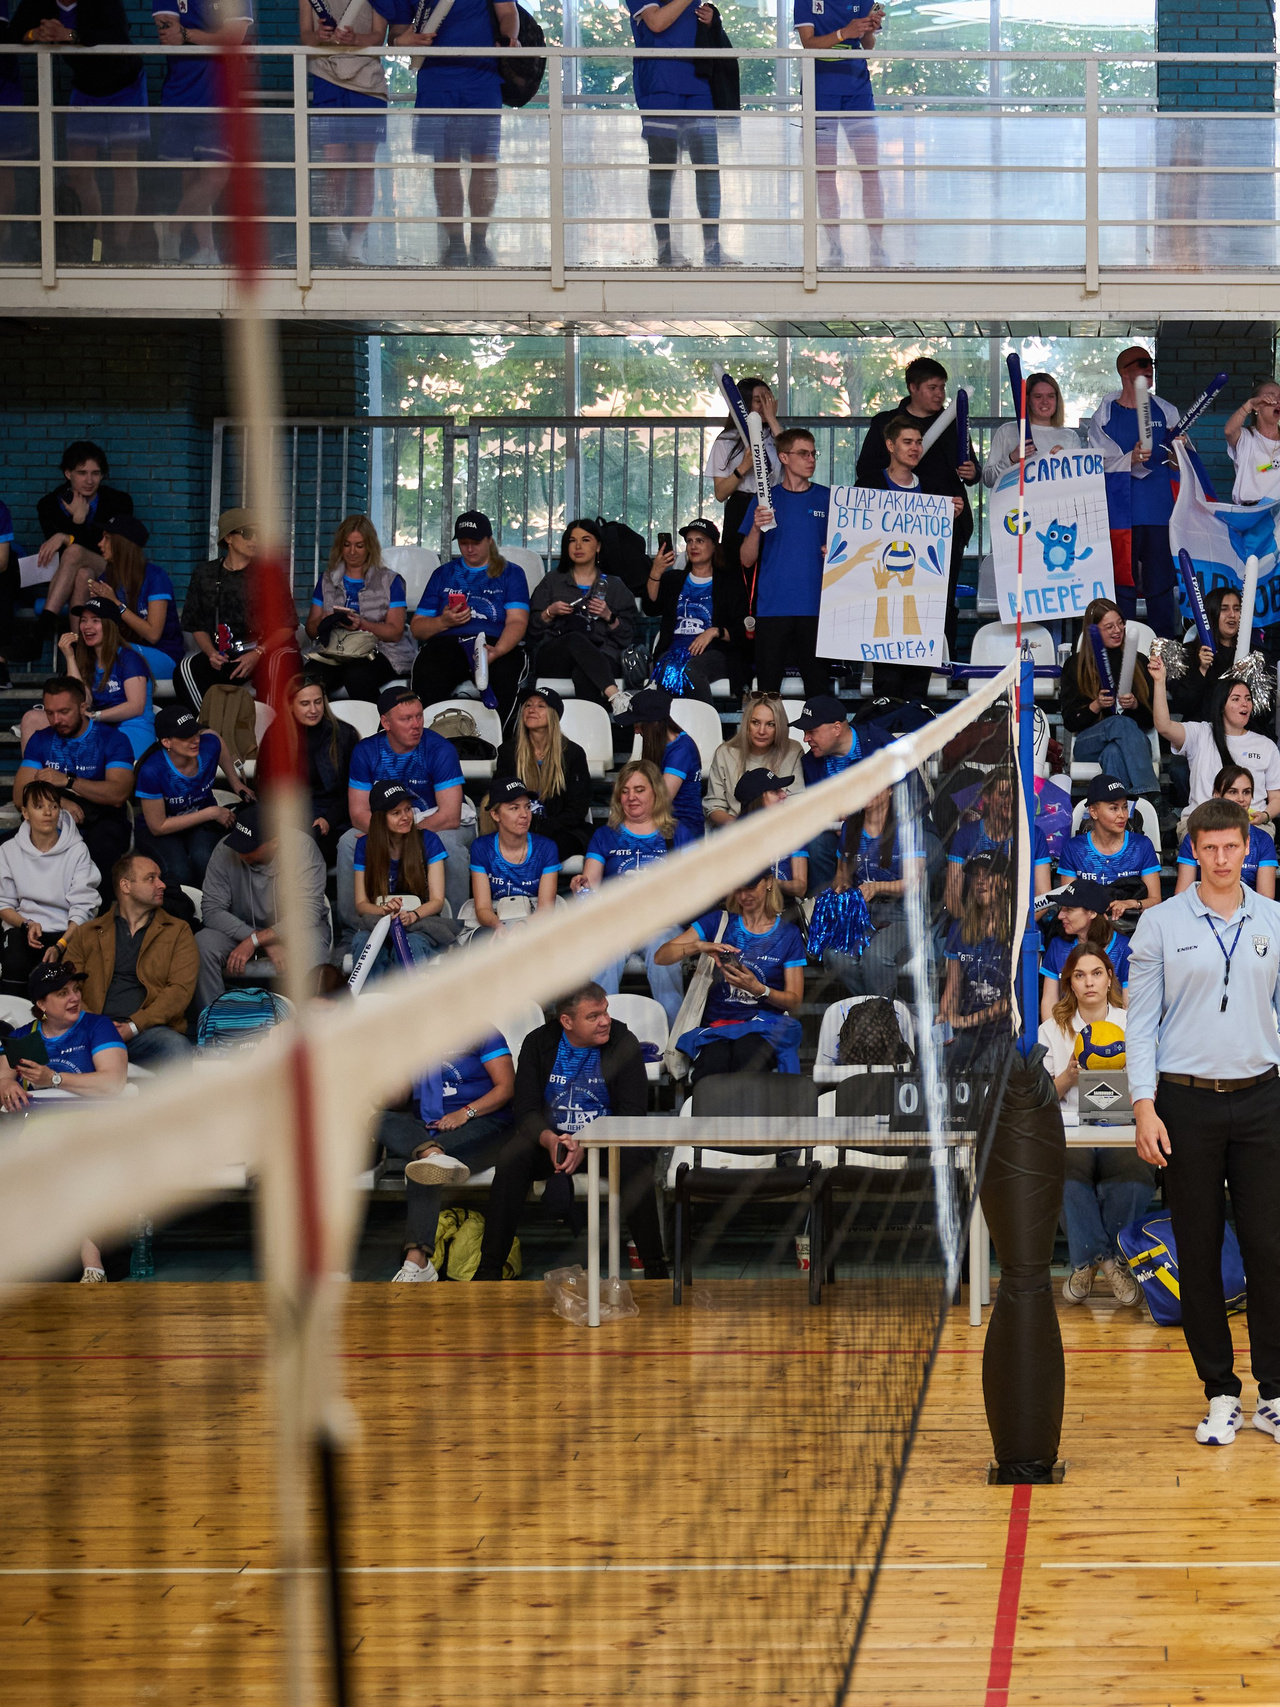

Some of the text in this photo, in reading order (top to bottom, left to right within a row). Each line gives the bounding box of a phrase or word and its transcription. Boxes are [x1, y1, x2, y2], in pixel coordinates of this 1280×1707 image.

[753, 444, 763, 479] ГРУППЫ
[1024, 454, 1104, 484] САРАТОВ
[834, 485, 948, 516] СПАРТАКИАДА
[813, 510, 826, 518] ВТБ
[837, 506, 953, 539] ВТБ САРАТОВ
[1191, 576, 1210, 631] ГРУППЫ ВТБ
[169, 796, 185, 804] ВТБ
[616, 848, 632, 857] ВТБ
[1082, 872, 1097, 881] ВТБ
[361, 943, 372, 961] ВТБ
[960, 953, 974, 962] ВТБ
[549, 1073, 567, 1085] ВТБ
[898, 1082, 919, 1114] 0
[955, 1082, 970, 1104] 0
